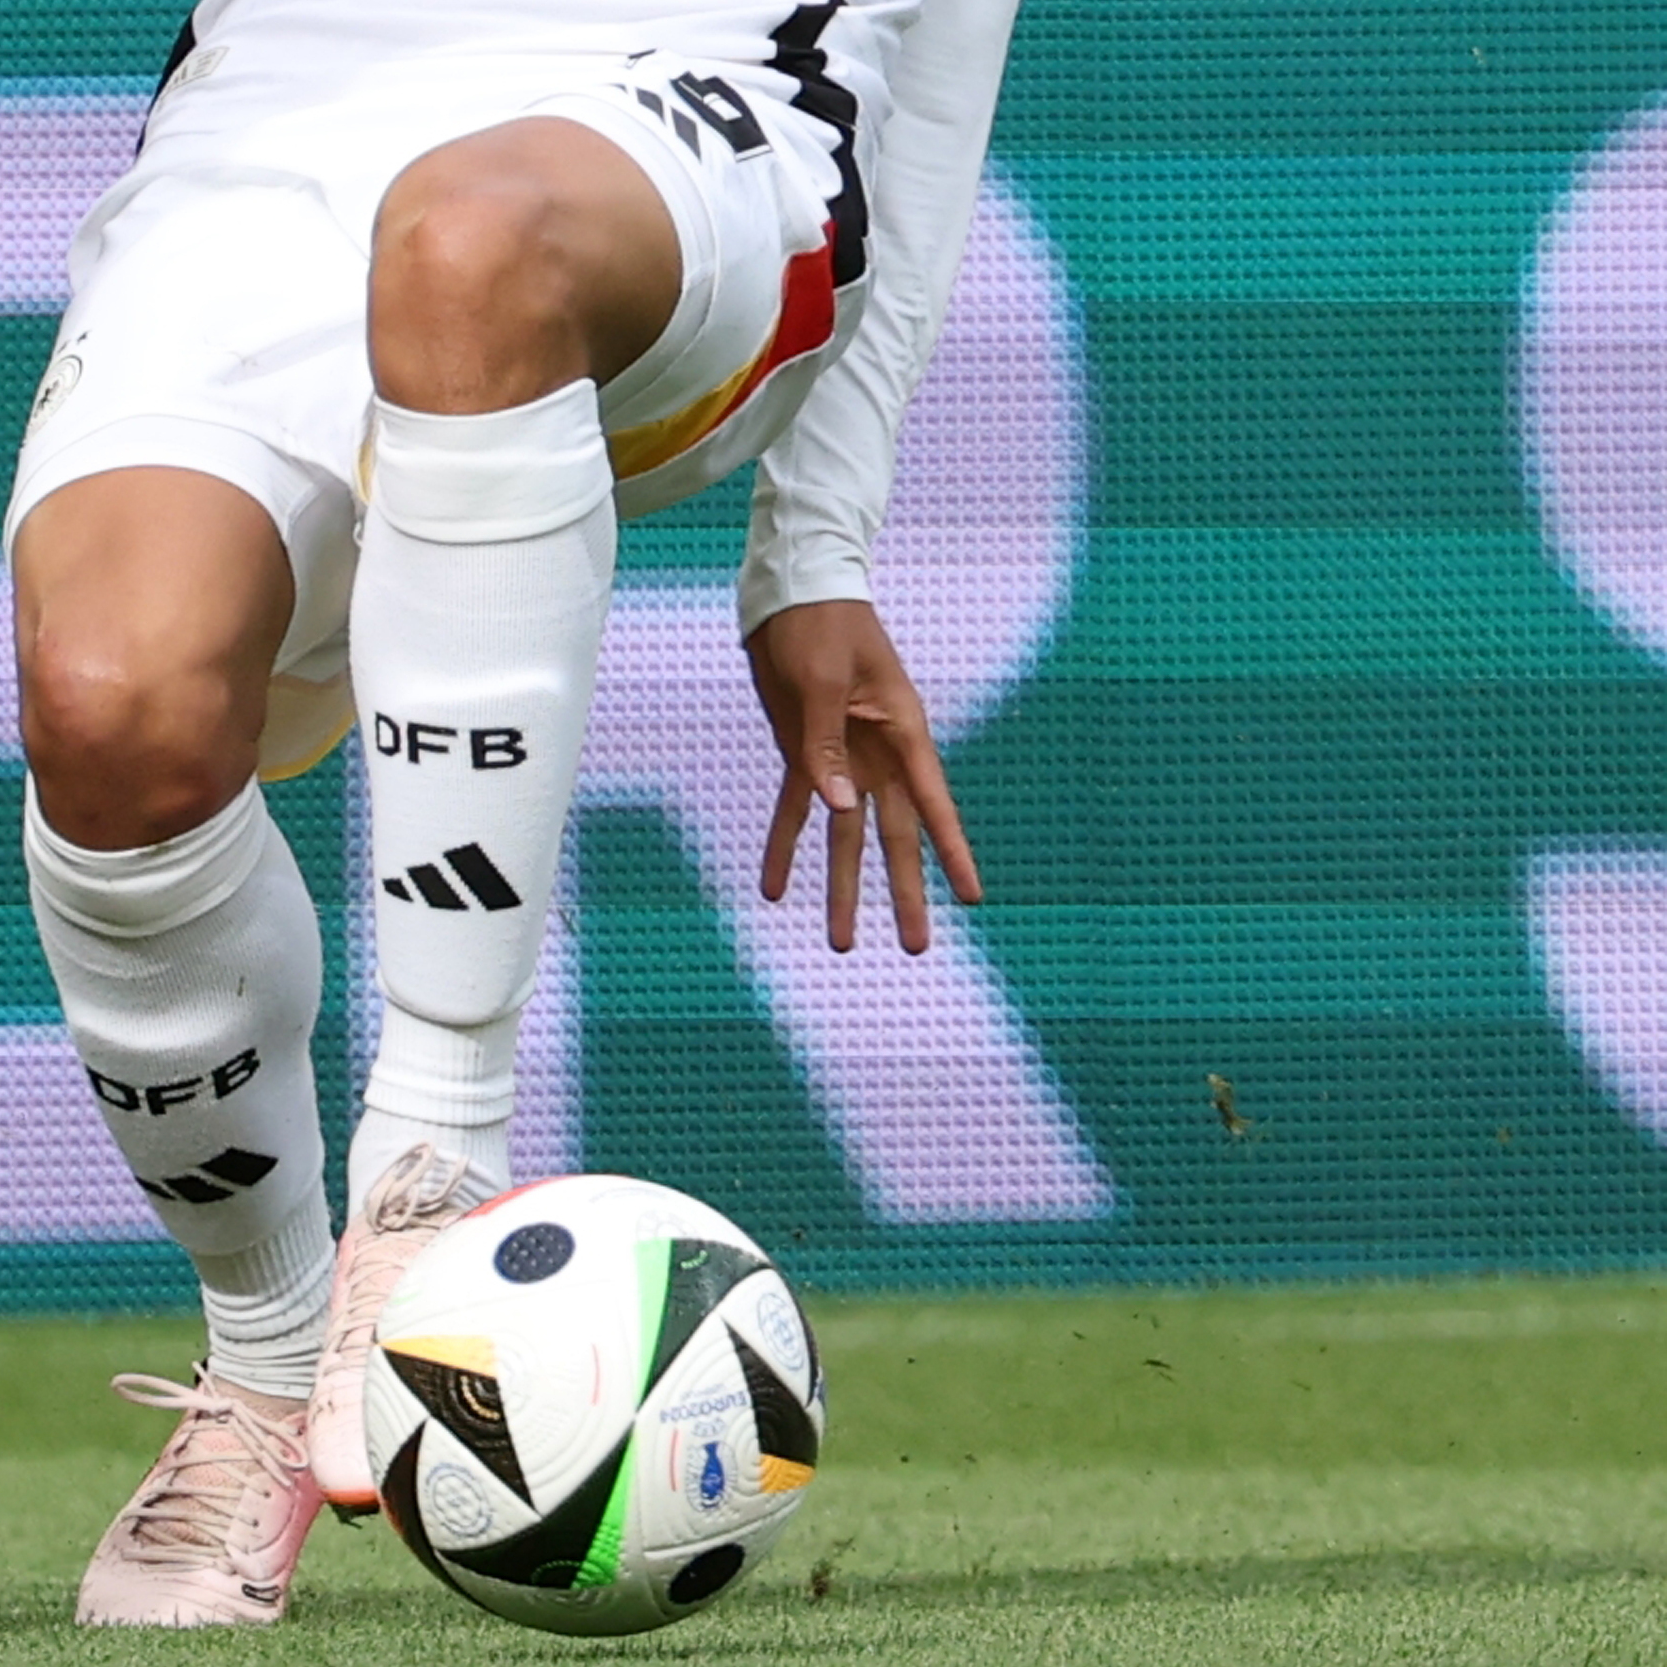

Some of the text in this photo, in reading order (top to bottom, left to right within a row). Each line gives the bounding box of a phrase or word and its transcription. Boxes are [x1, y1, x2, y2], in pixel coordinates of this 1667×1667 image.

[374, 712, 528, 770] DFB
[84, 1047, 262, 1116] DFB
[660, 1391, 748, 1424] EURO2024
